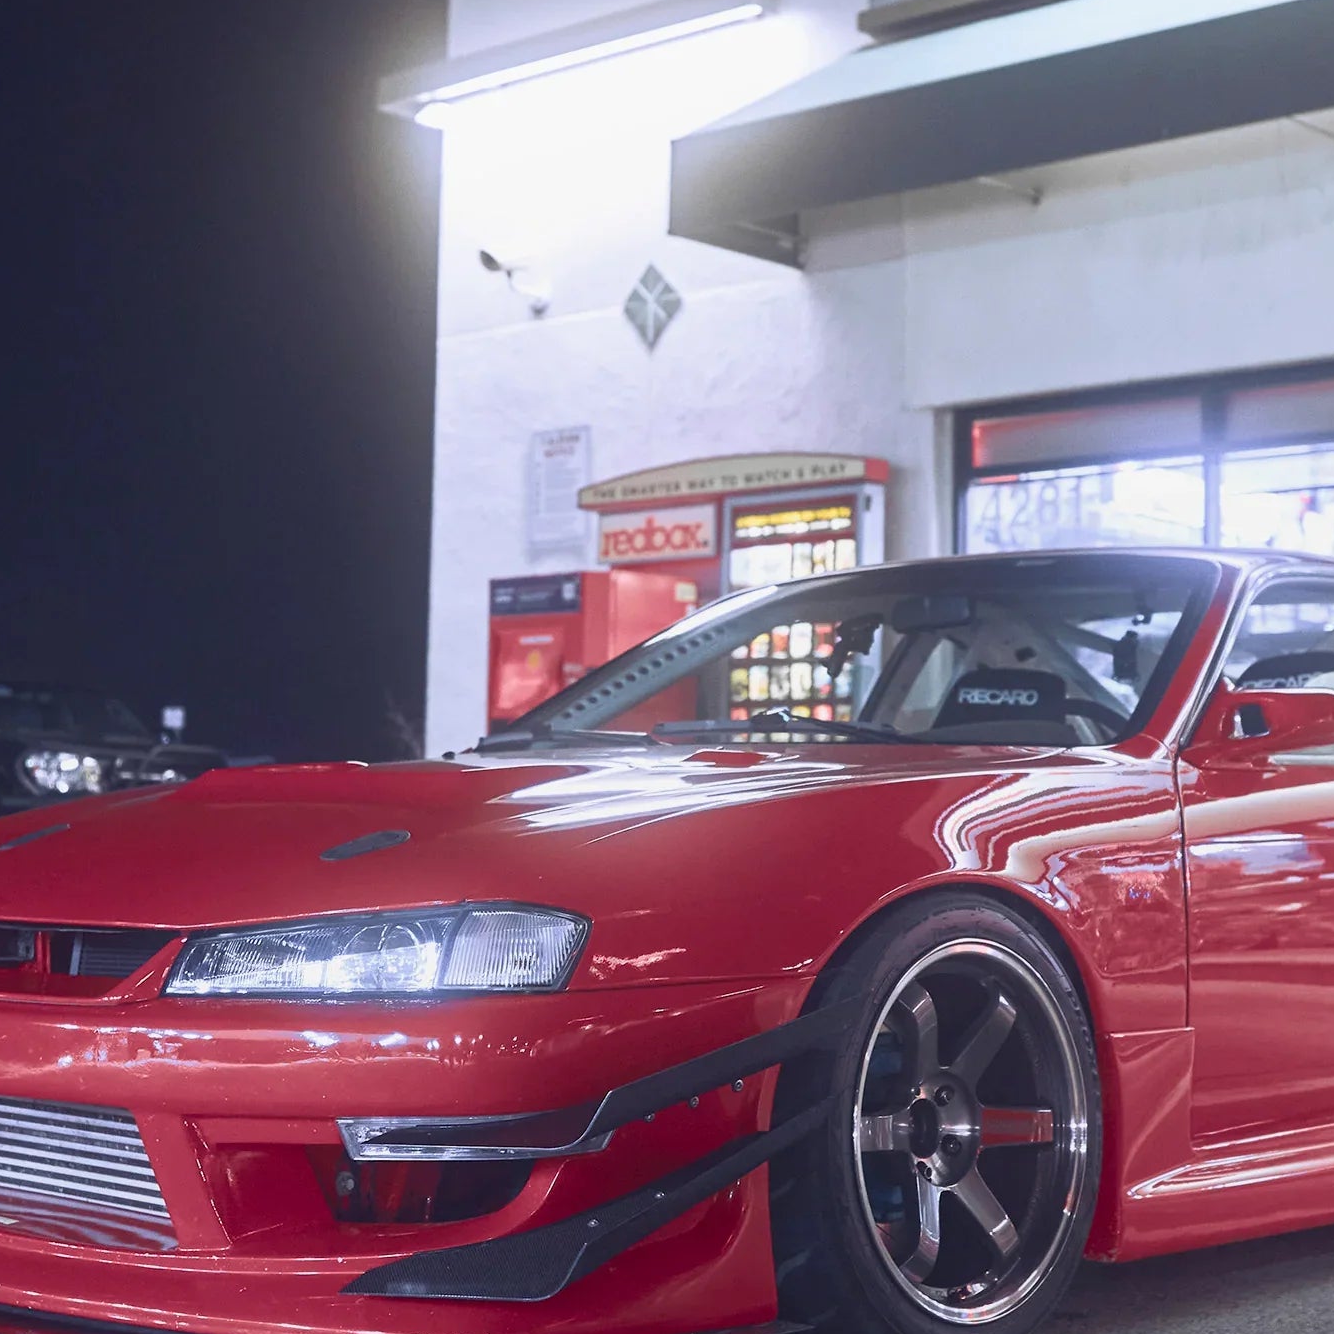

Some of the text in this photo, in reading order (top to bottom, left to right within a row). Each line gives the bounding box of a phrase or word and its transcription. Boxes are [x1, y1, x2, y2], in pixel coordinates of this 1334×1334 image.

[593, 489, 615, 499] THE
[621, 481, 680, 495] SMARTER
[687, 477, 715, 489] WAY
[721, 474, 739, 486] TO
[744, 469, 792, 484] WATCH
[810, 462, 846, 477] PLAY
[958, 687, 1039, 706] RECARO
